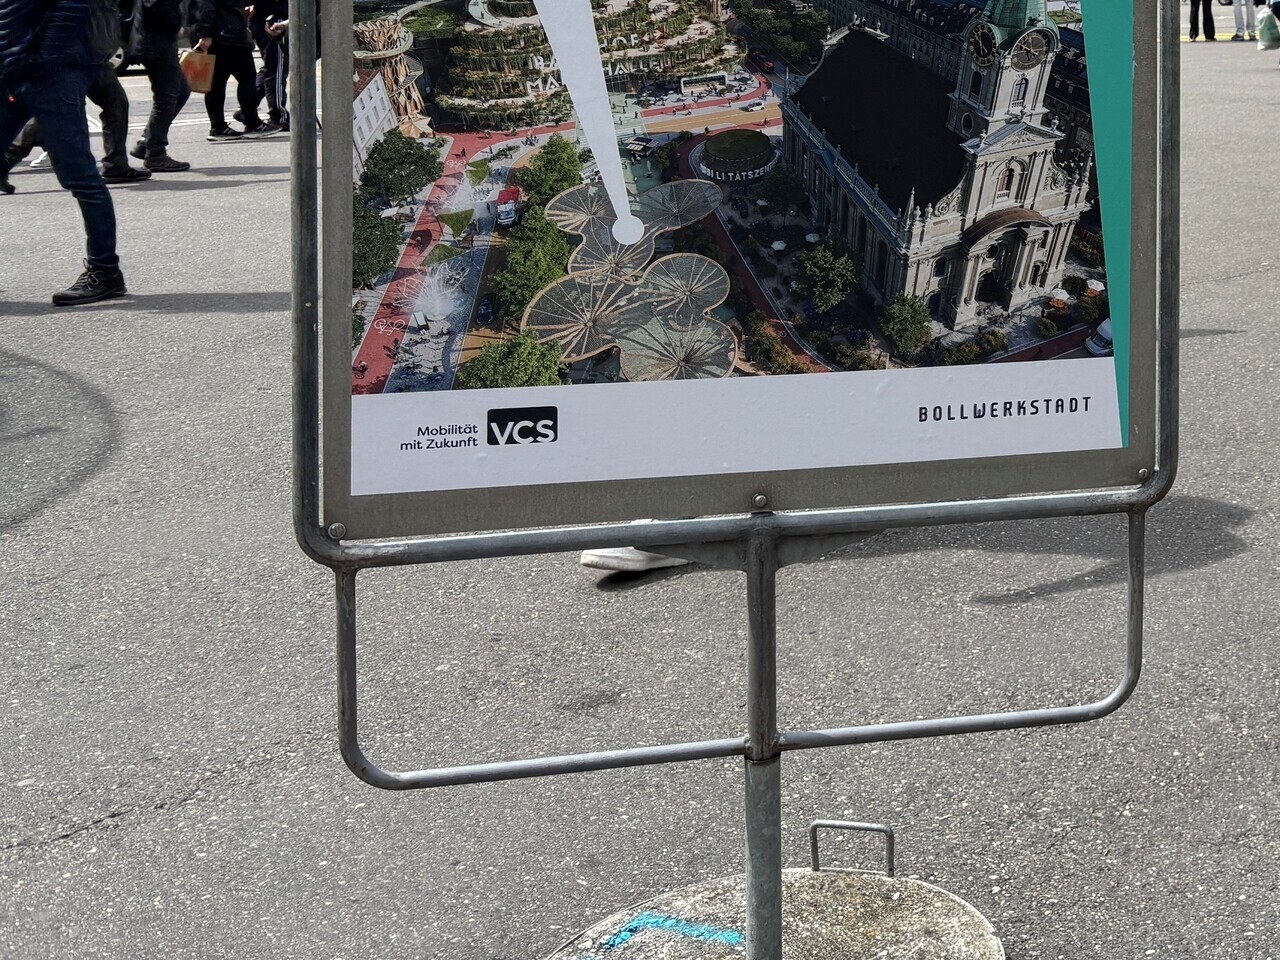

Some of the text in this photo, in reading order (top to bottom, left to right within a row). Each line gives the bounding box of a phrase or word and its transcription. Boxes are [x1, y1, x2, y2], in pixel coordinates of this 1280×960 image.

[918, 396, 1092, 422] BOLLWERKSTADT
[400, 437, 479, 451] mit Zukunft
[417, 419, 555, 445] Mobilität VCS
